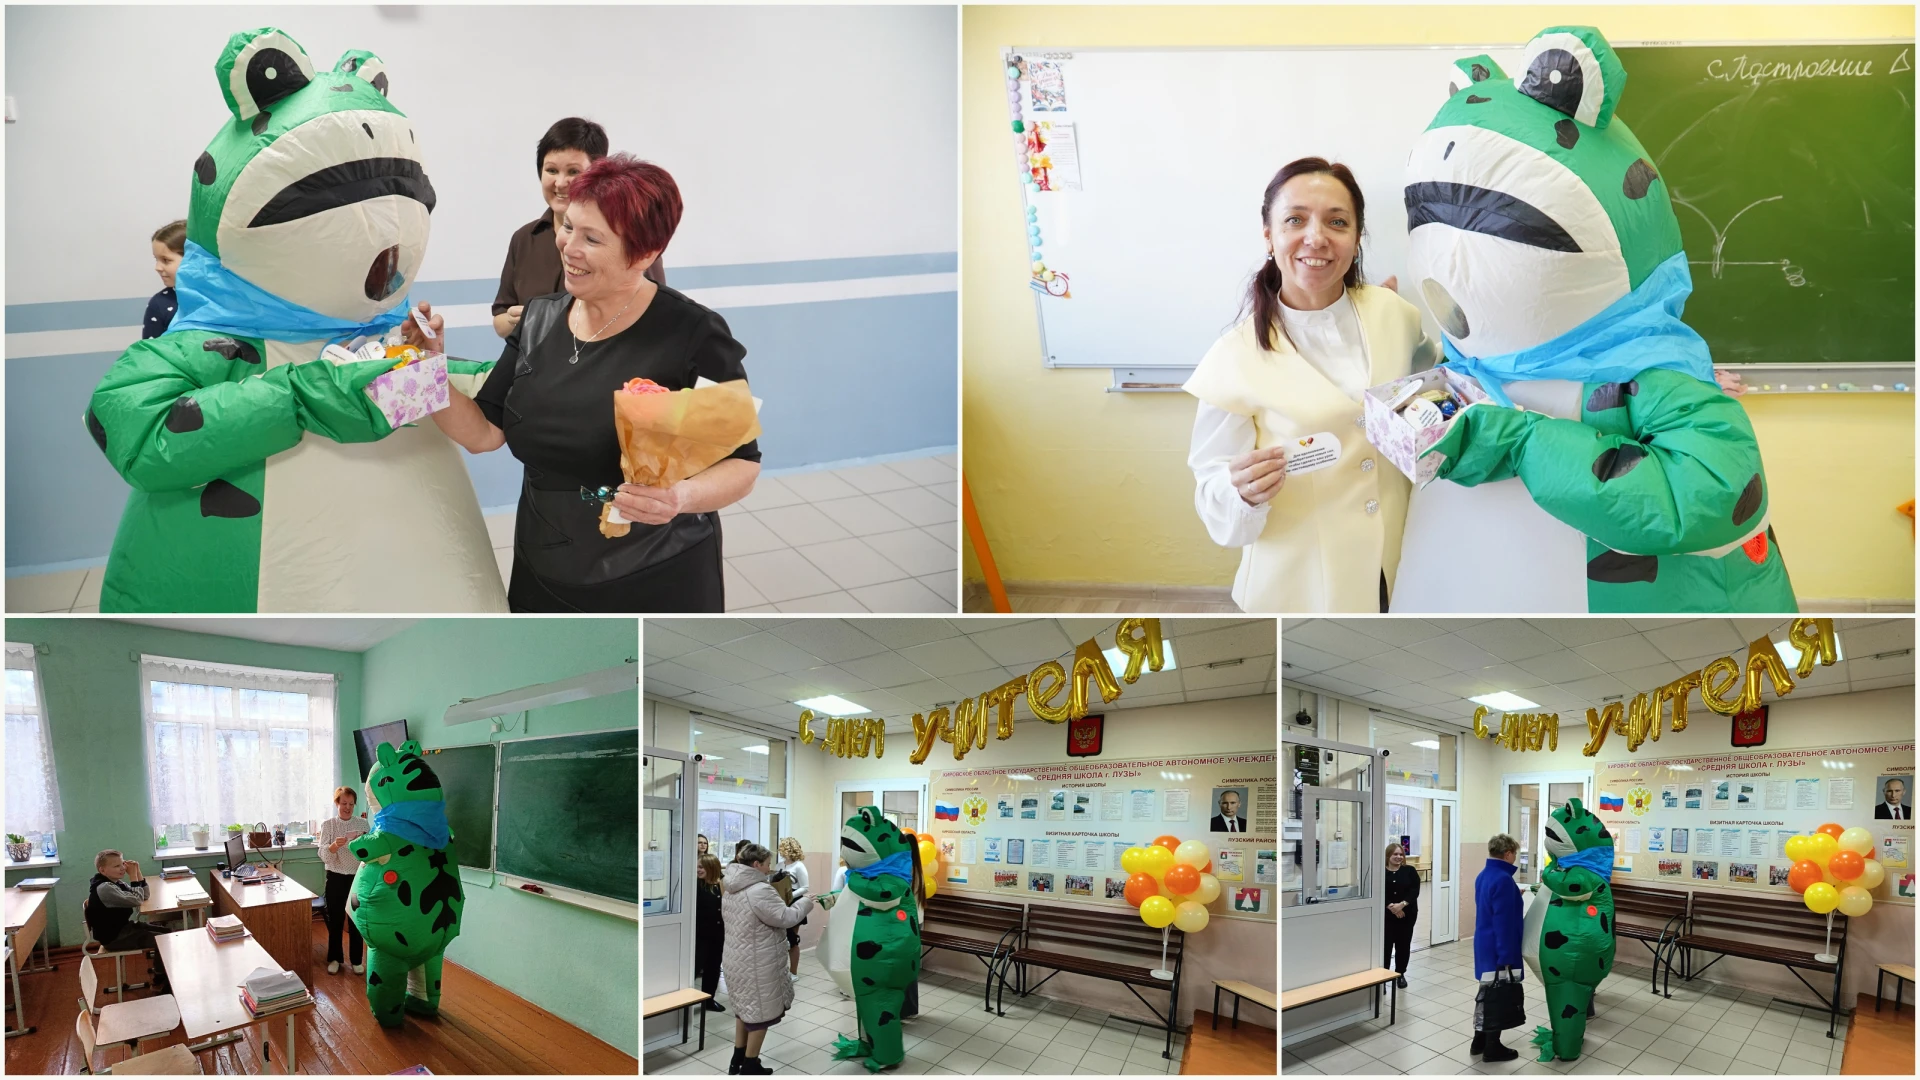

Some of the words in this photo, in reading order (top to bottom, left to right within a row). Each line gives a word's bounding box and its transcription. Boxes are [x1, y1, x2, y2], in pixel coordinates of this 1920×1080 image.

[799, 709, 815, 745] С
[1474, 705, 1489, 739] С
[973, 768, 1007, 777] ОБЛАСТНОЕ
[1007, 764, 1068, 776] ГОСУДАРСТВЕННОЕ
[1069, 760, 1164, 772] ОБЩЕОБРАЗОВАТЕЛЬНОЕ
[1165, 757, 1225, 767] АВТОНОМНОЕ
[1637, 760, 1671, 768] ОБЛАСТНОЕ
[1671, 755, 1732, 766] ГОСУДАРСТВЕННОЕ
[1733, 749, 1828, 761] ОБЩЕОБРАЗОВАТЕЛЬНОЕ
[1829, 746, 1889, 756] АВТОНОМНОЕ
[1738, 761, 1767, 770] ШКОЛА
[1777, 760, 1806, 768] ЛУЗЫ»
[1073, 771, 1104, 780] ШКОЛА
[1112, 769, 1142, 778] ЛУЗЫ»
